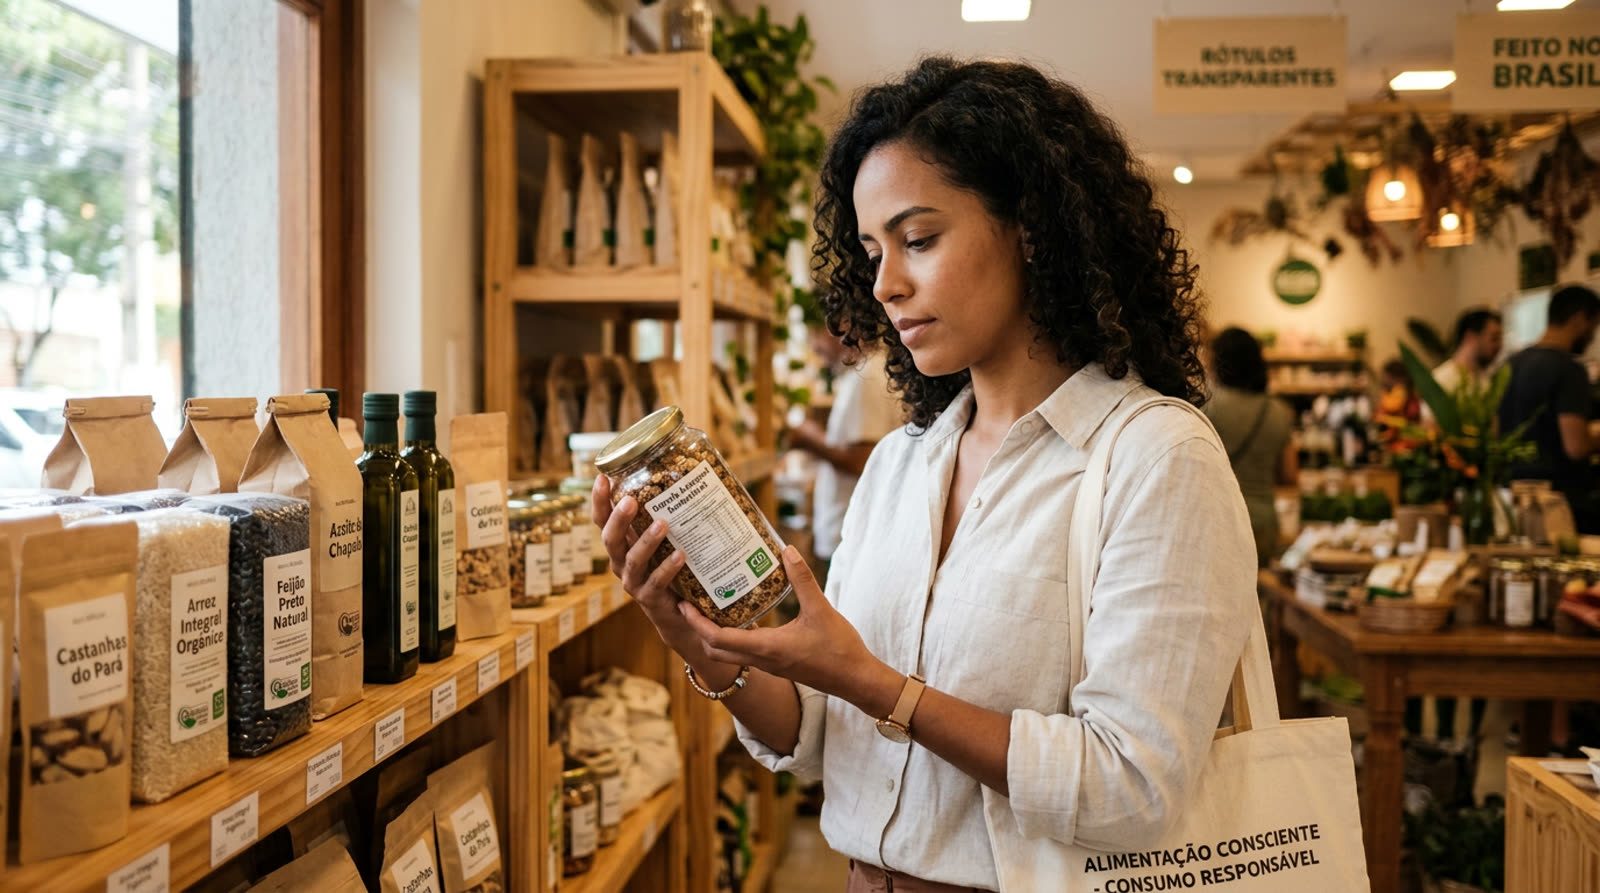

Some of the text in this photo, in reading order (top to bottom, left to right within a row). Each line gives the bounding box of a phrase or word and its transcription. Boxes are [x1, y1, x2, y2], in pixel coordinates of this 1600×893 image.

[1201, 43, 1297, 64] RÓTULOS
[1493, 36, 1600, 57] FEITO NO
[1162, 68, 1336, 87] TRANSPARENTES
[1493, 62, 1600, 88] BRASIL
[277, 575, 305, 595] Feijão
[279, 594, 304, 611] Preto
[273, 606, 308, 630] Natural
[56, 634, 127, 665] Castanhas
[71, 654, 123, 685] do Pará
[1084, 823, 1321, 873] ALIMENTAÇÃO CONSCIENTE
[1104, 872, 1196, 893] CONSUMO
[1200, 849, 1320, 886] RESPONSÁVEL
